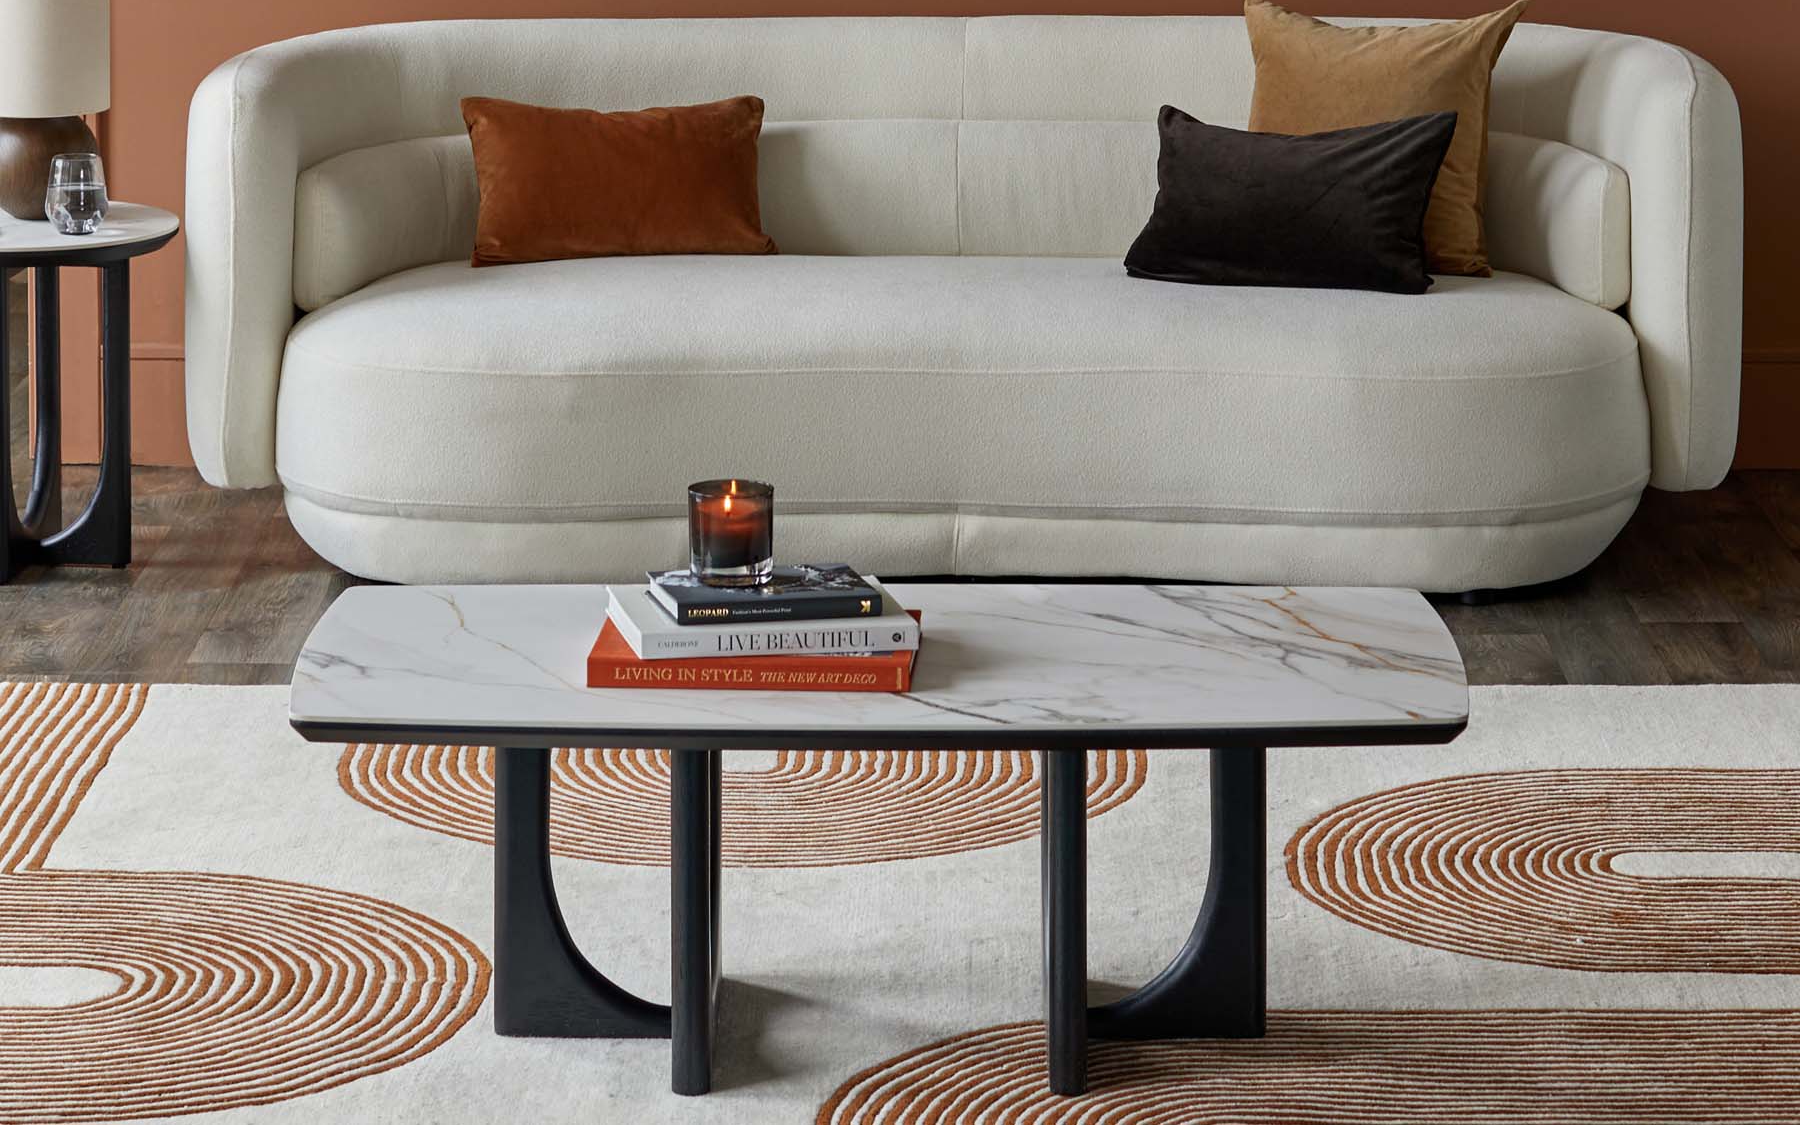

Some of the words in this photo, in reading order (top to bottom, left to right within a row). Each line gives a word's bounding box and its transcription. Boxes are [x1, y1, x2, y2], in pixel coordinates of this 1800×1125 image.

[688, 608, 729, 618] LEOPARD
[717, 634, 761, 651] LIVE
[767, 630, 875, 650] BEAUTIFUL
[614, 667, 673, 681] LIVING
[678, 668, 697, 681] IN
[701, 669, 753, 682] STYLE
[760, 671, 786, 683] THE
[788, 672, 817, 683] NEW
[818, 672, 843, 684] ART
[844, 673, 877, 684] DECO
